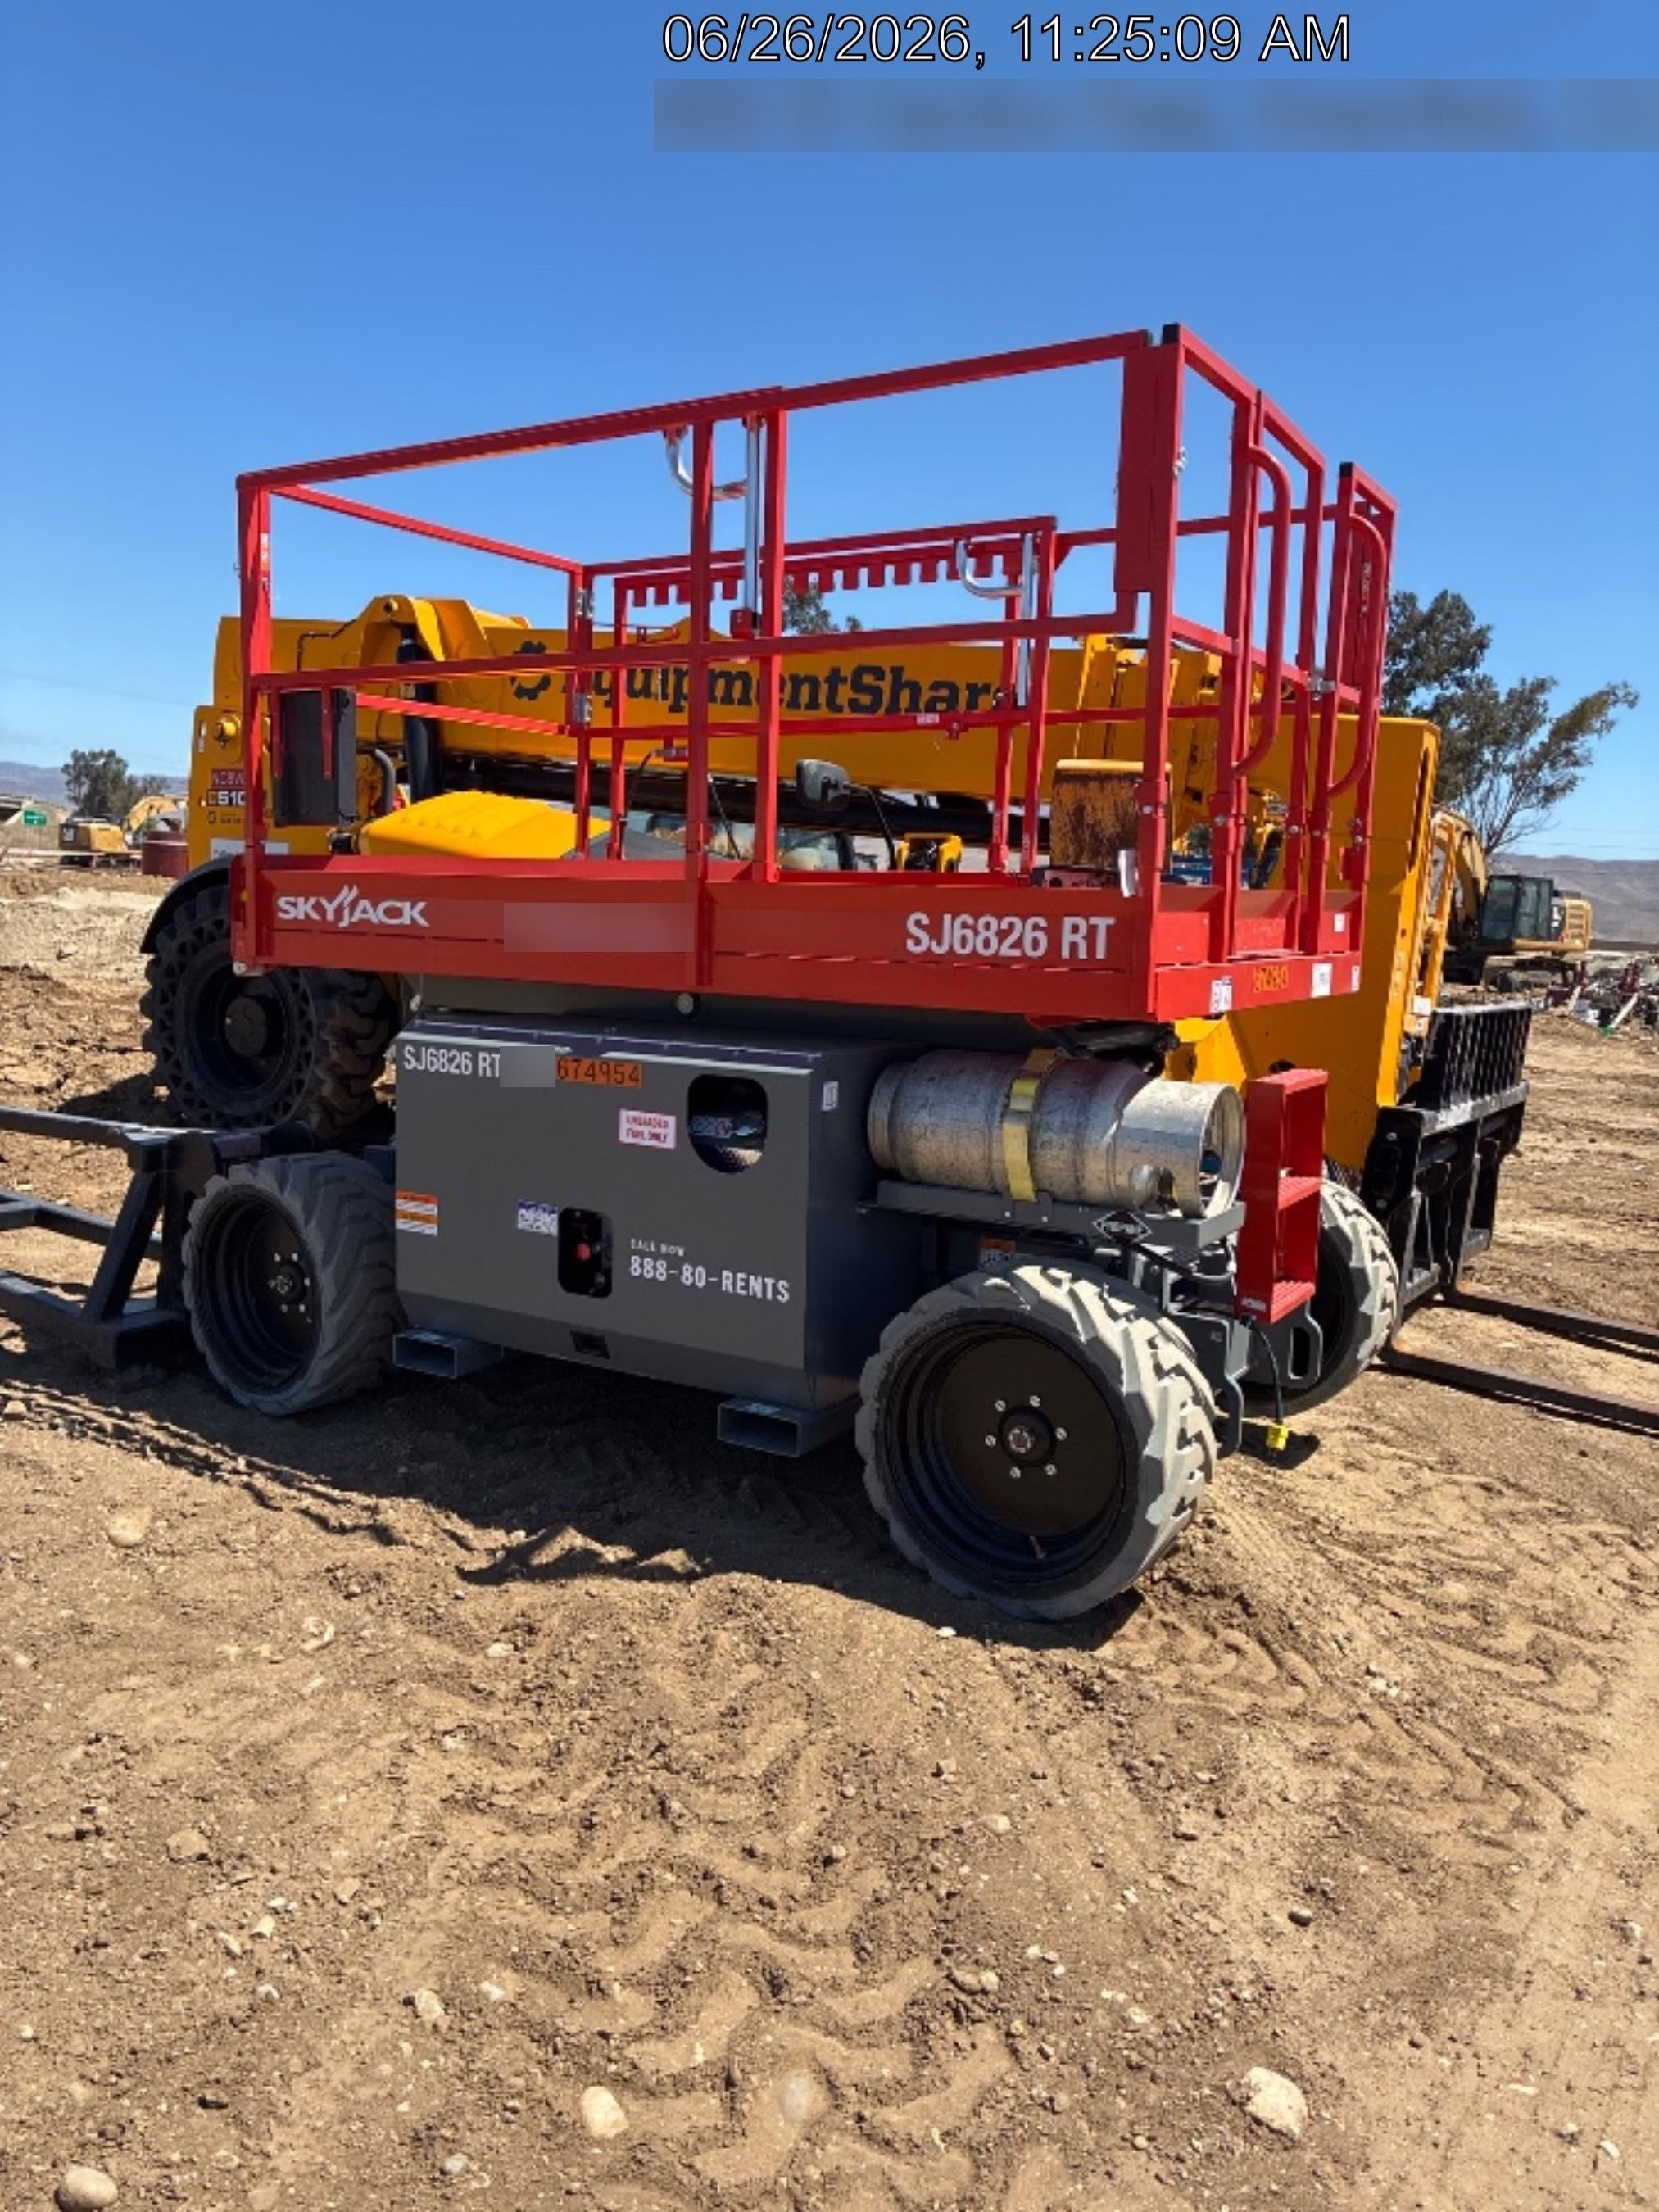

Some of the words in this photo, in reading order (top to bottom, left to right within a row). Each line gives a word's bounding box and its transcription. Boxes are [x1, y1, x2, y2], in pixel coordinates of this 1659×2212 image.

[277, 884, 430, 927] SKYJACK
[905, 911, 1049, 958] SJ6826
[1060, 916, 1117, 959] RT
[402, 1045, 473, 1075] SJ6826
[478, 1052, 500, 1077] RT
[556, 1057, 641, 1085] 674954
[630, 1255, 790, 1303] 888-80-RENTS
